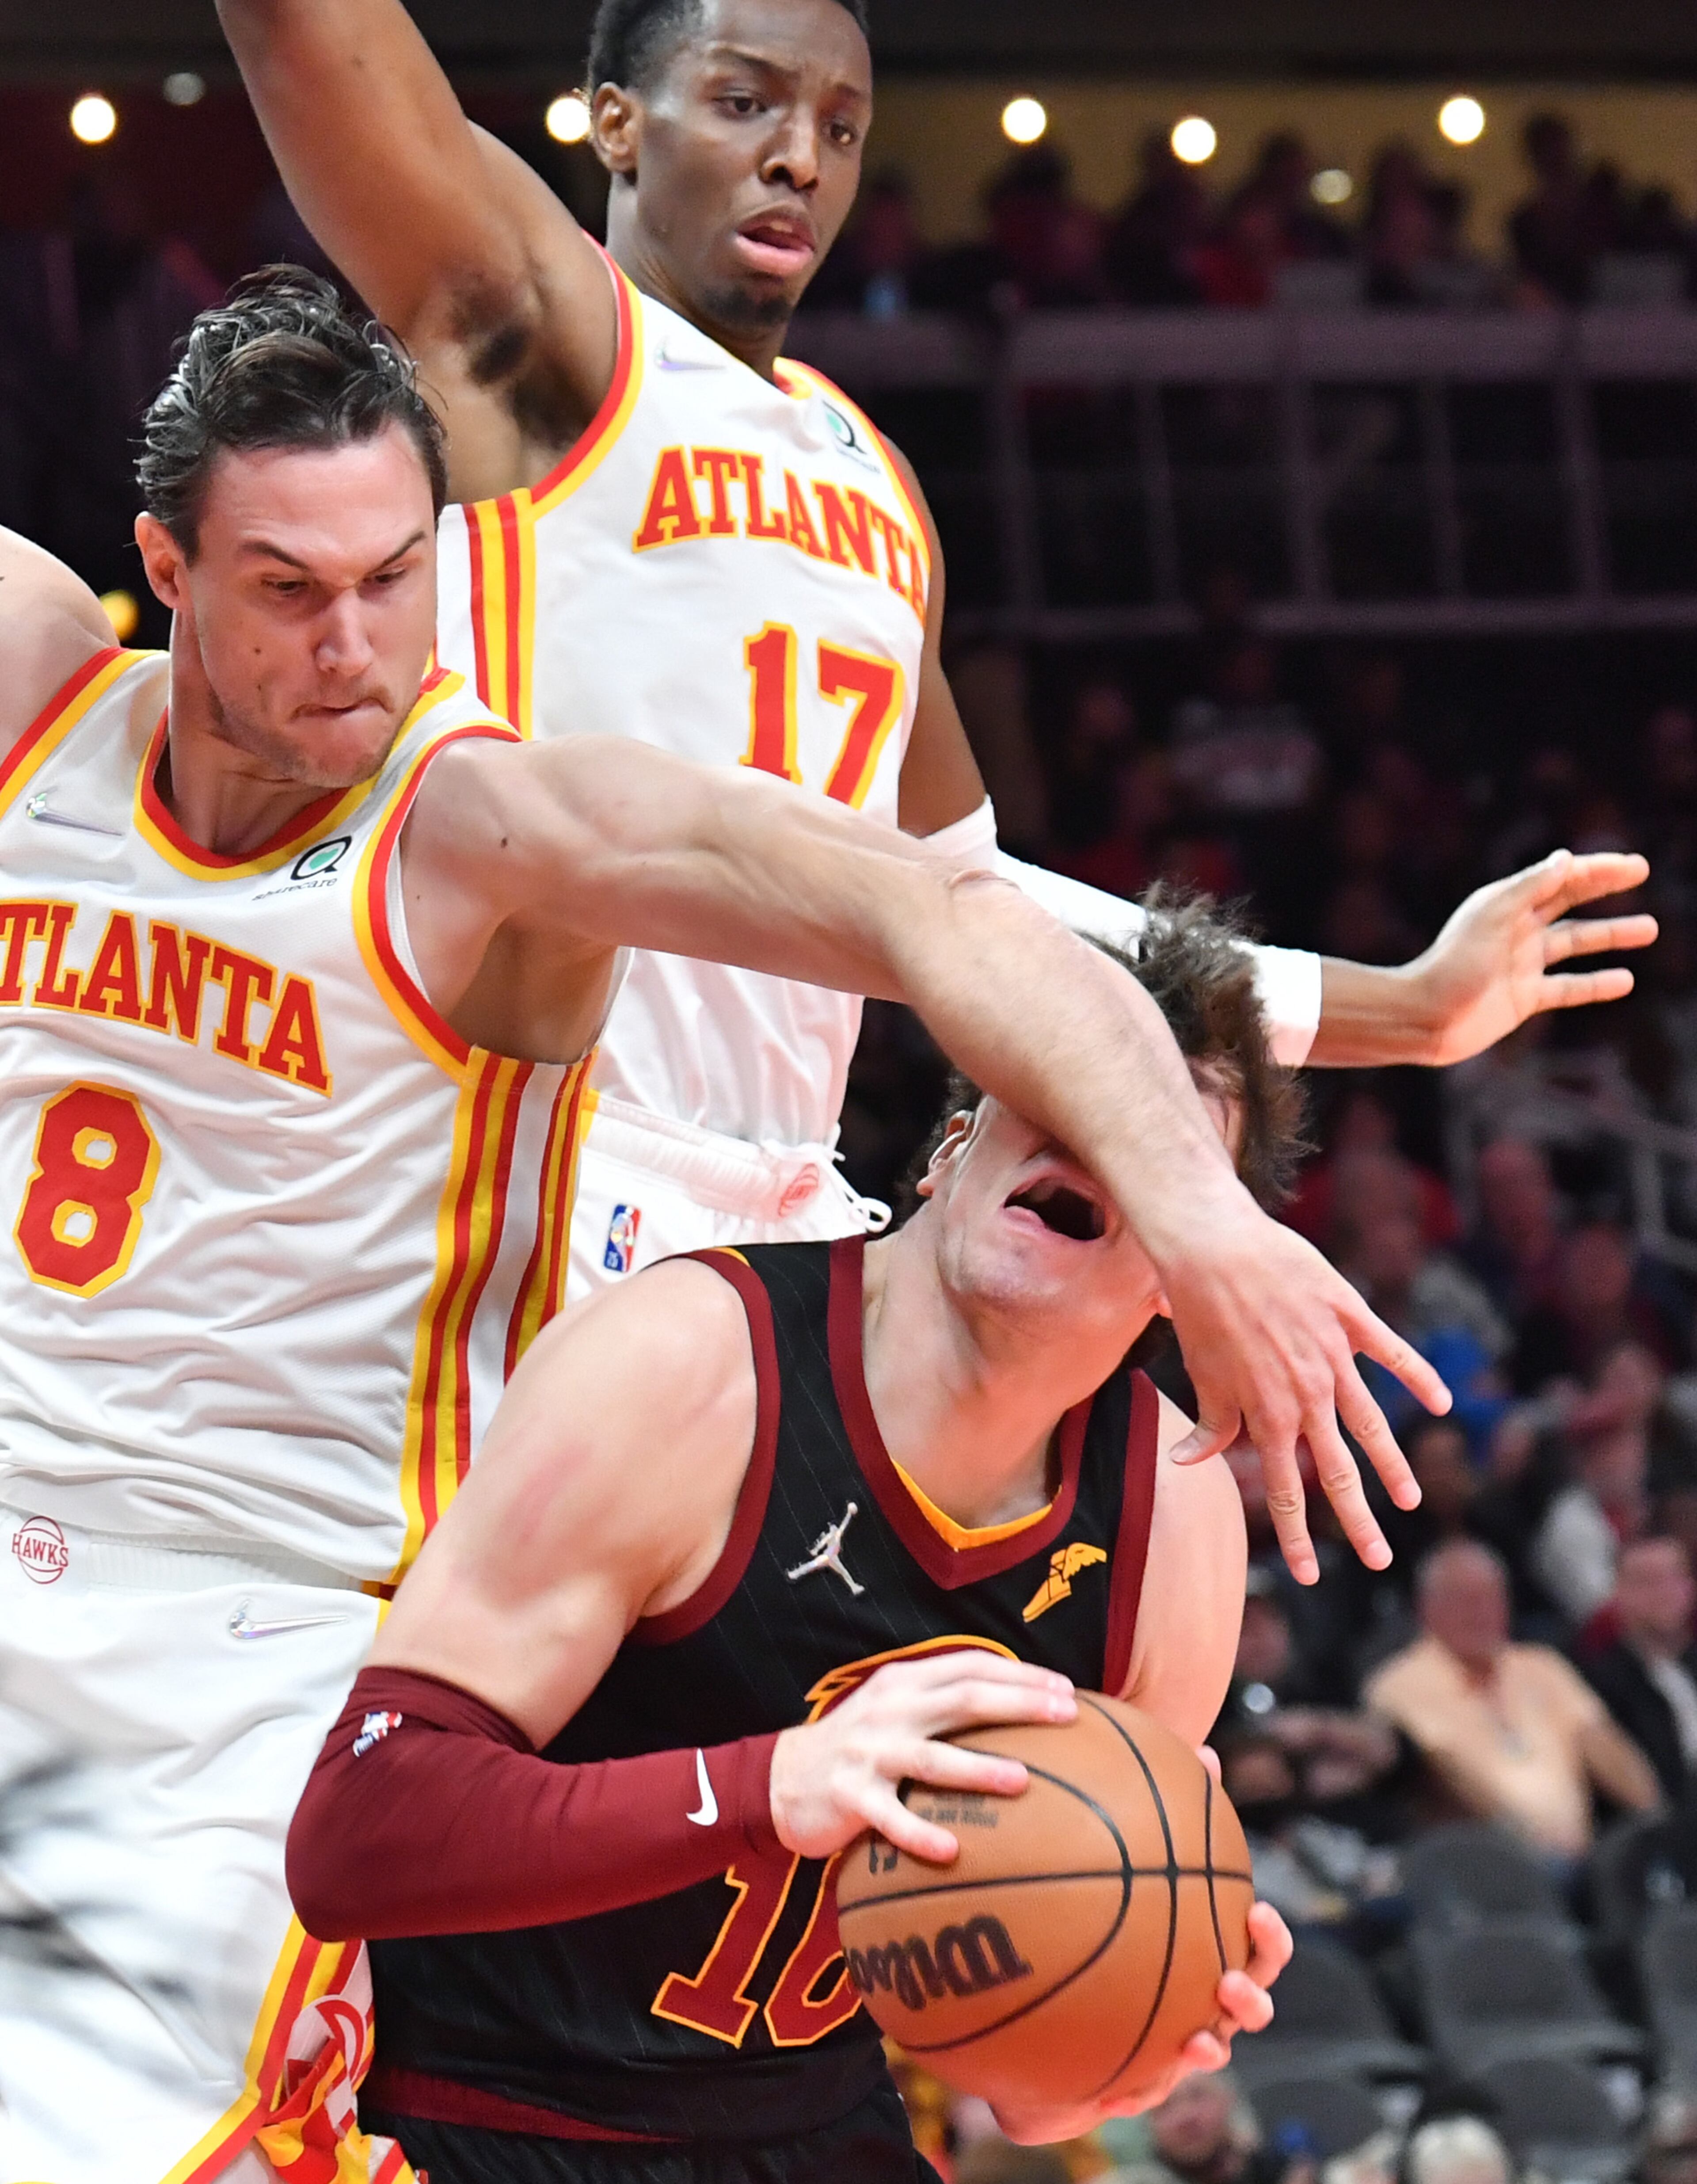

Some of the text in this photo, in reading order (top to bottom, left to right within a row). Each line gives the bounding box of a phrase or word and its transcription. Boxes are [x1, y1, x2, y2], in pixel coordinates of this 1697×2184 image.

[738, 621, 906, 811] 17
[0, 898, 332, 1098] TLANTA
[12, 1080, 161, 1299] 8
[11, 1533, 69, 1567] HAWKS
